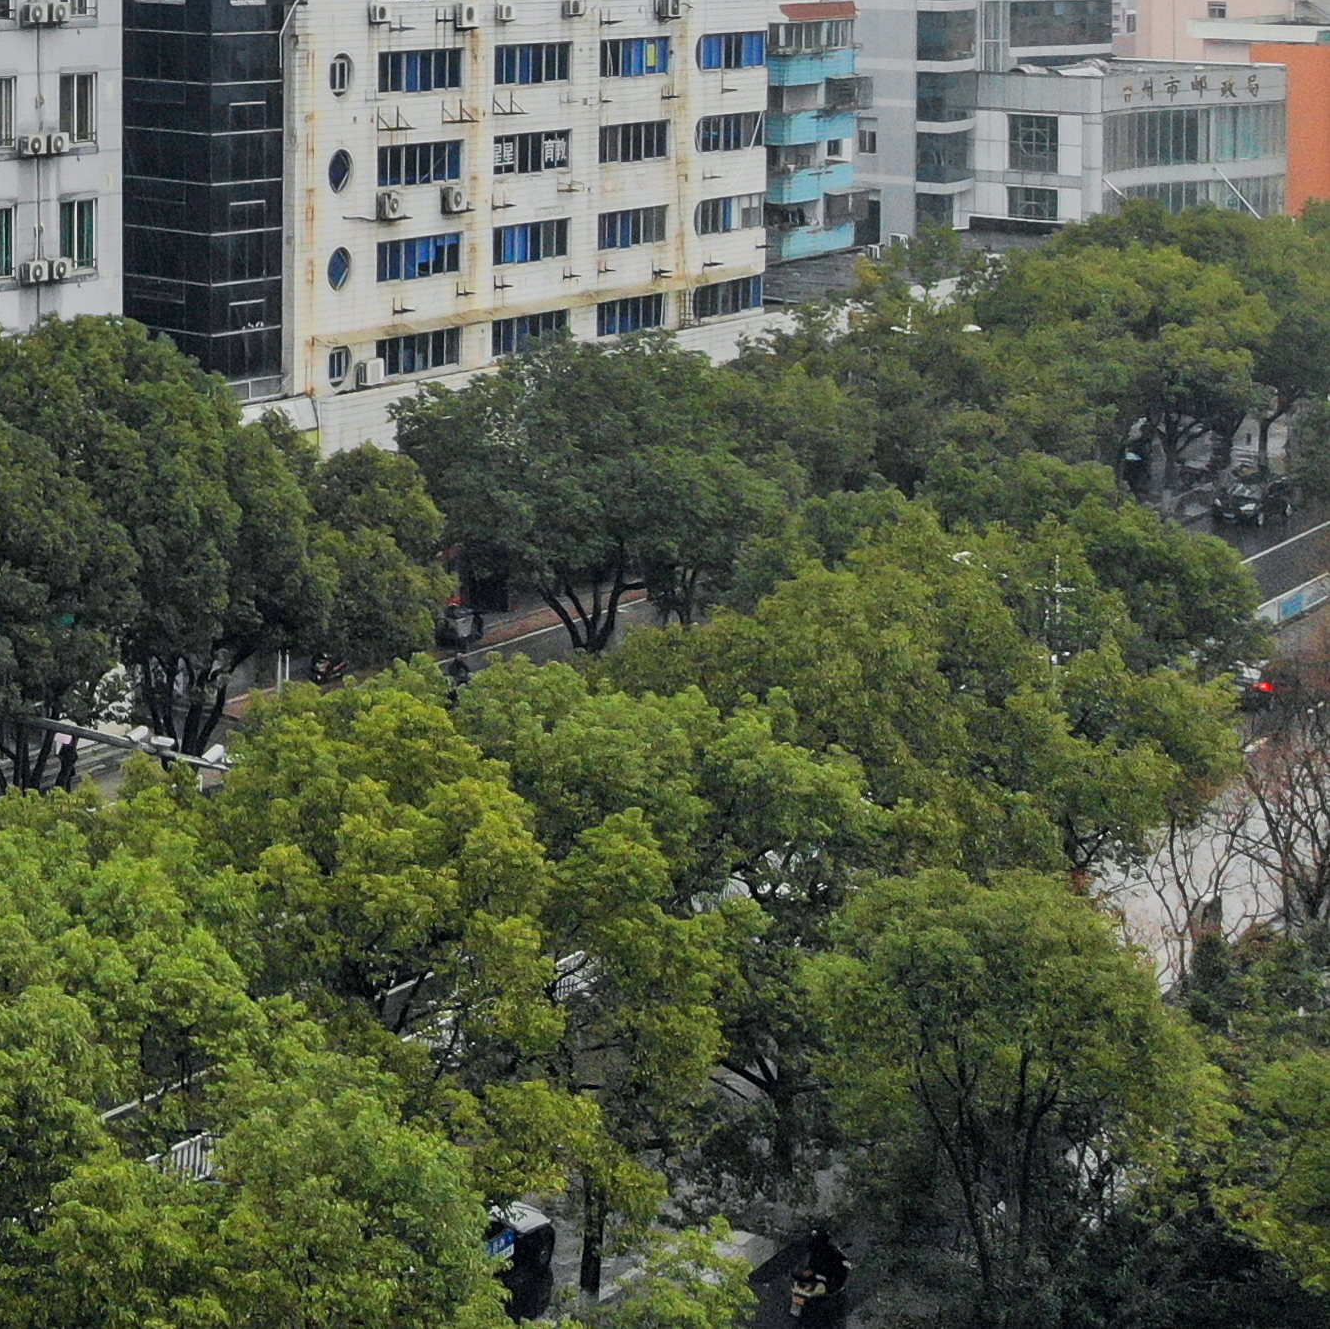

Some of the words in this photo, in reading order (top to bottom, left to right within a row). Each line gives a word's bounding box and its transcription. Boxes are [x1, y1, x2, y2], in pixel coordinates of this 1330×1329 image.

[1123, 74, 1259, 103] 台州市邮政局
